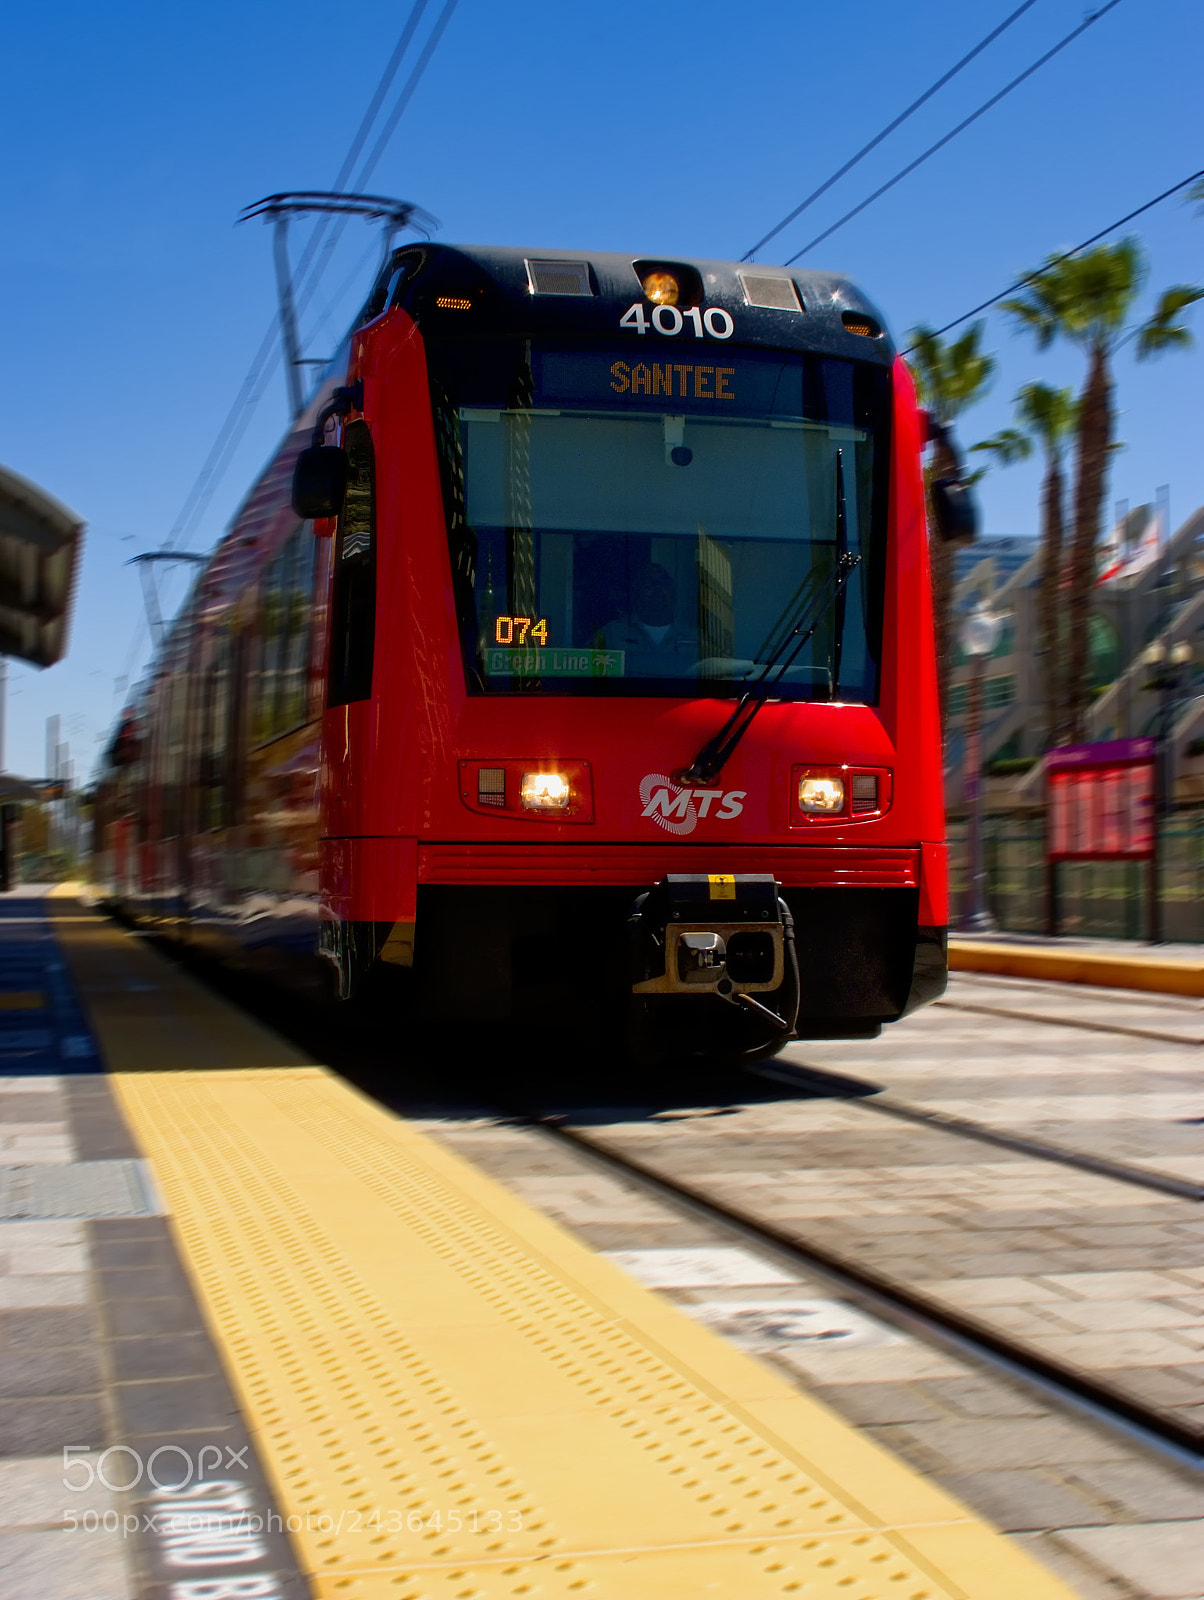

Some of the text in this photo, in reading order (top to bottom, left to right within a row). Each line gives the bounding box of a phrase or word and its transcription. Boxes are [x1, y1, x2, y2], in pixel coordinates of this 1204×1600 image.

[620, 304, 734, 340] 4010
[611, 361, 735, 399] SANTEE
[496, 617, 548, 645] 074
[493, 652, 589, 672] Green Line
[642, 789, 747, 819] MTS
